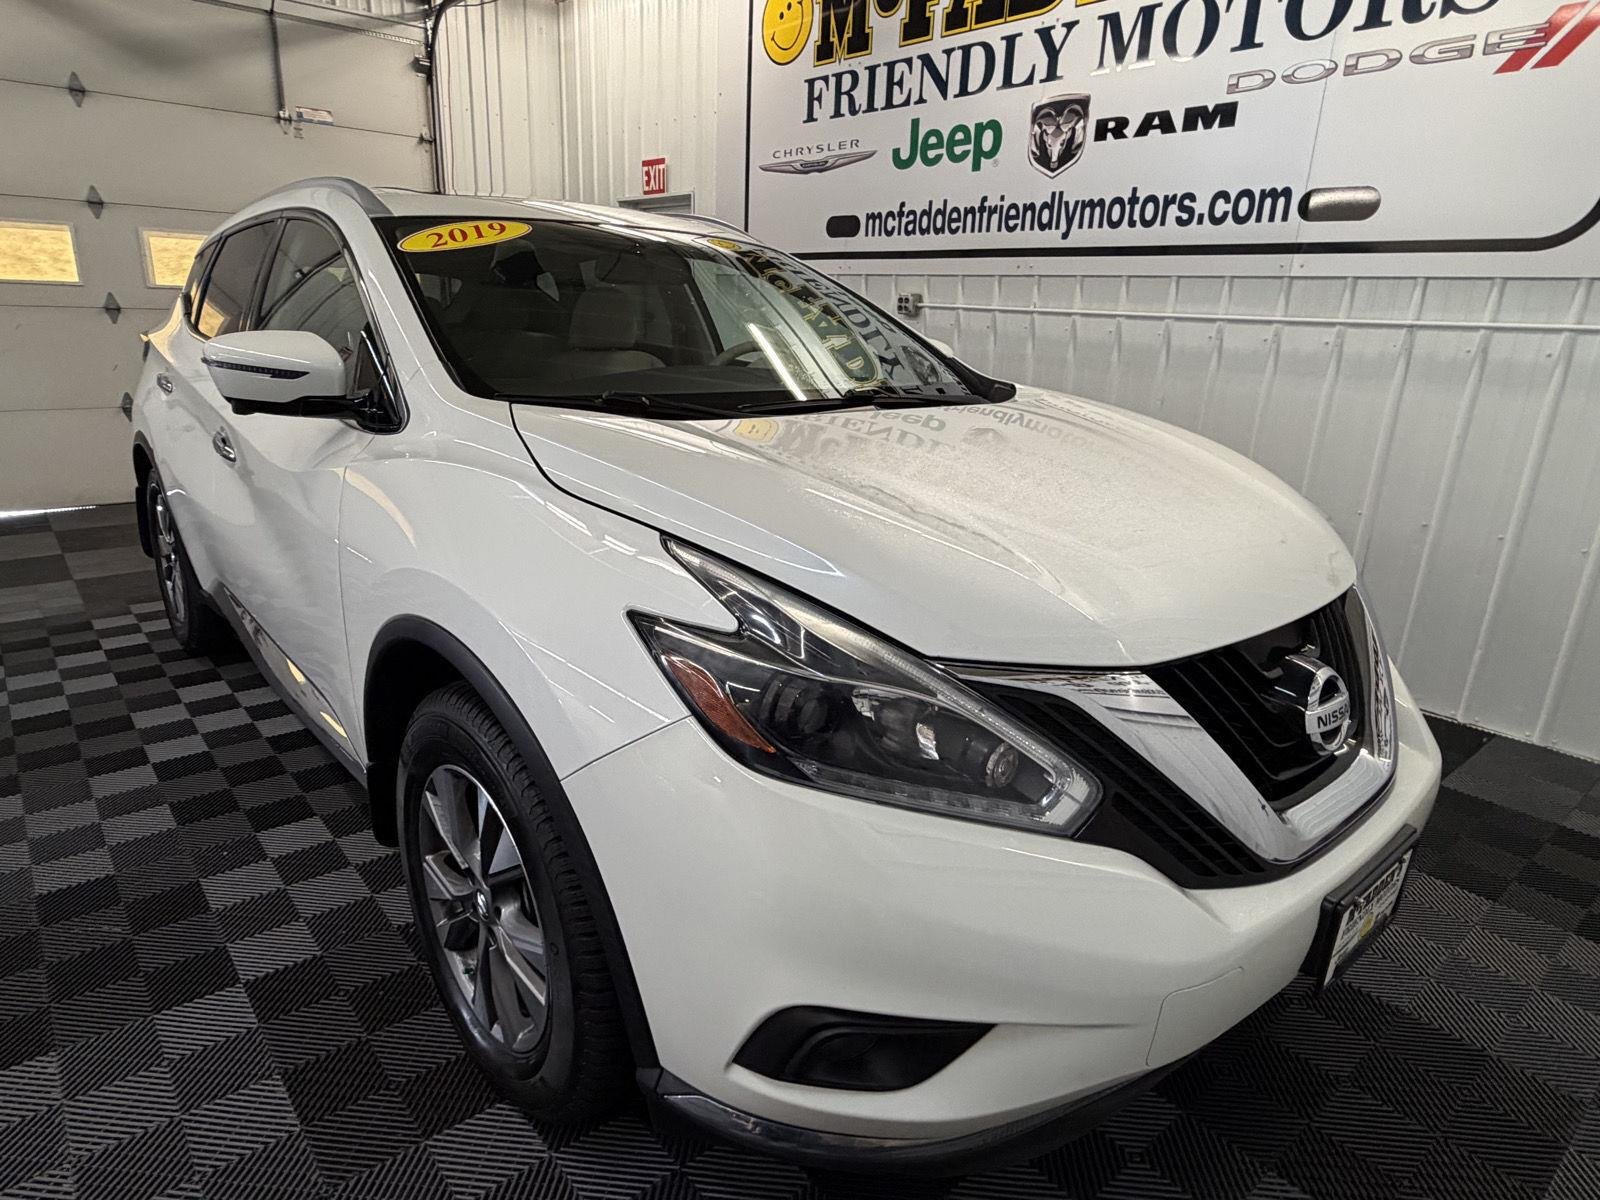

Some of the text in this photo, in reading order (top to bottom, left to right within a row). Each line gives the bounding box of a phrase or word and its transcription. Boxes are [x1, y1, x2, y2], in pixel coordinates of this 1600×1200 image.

[802, 20, 1080, 124] FRIENDLY
[1226, 23, 1551, 94] DODGE
[1094, 101, 1239, 142] RAM
[772, 138, 861, 159] CHRYSLER
[892, 117, 1002, 172] Jeep
[643, 164, 666, 191] EXIT
[864, 186, 1293, 241] mcfaddenfriendlymotors.com
[426, 222, 506, 248] 2019
[1317, 702, 1349, 729] NISSA
